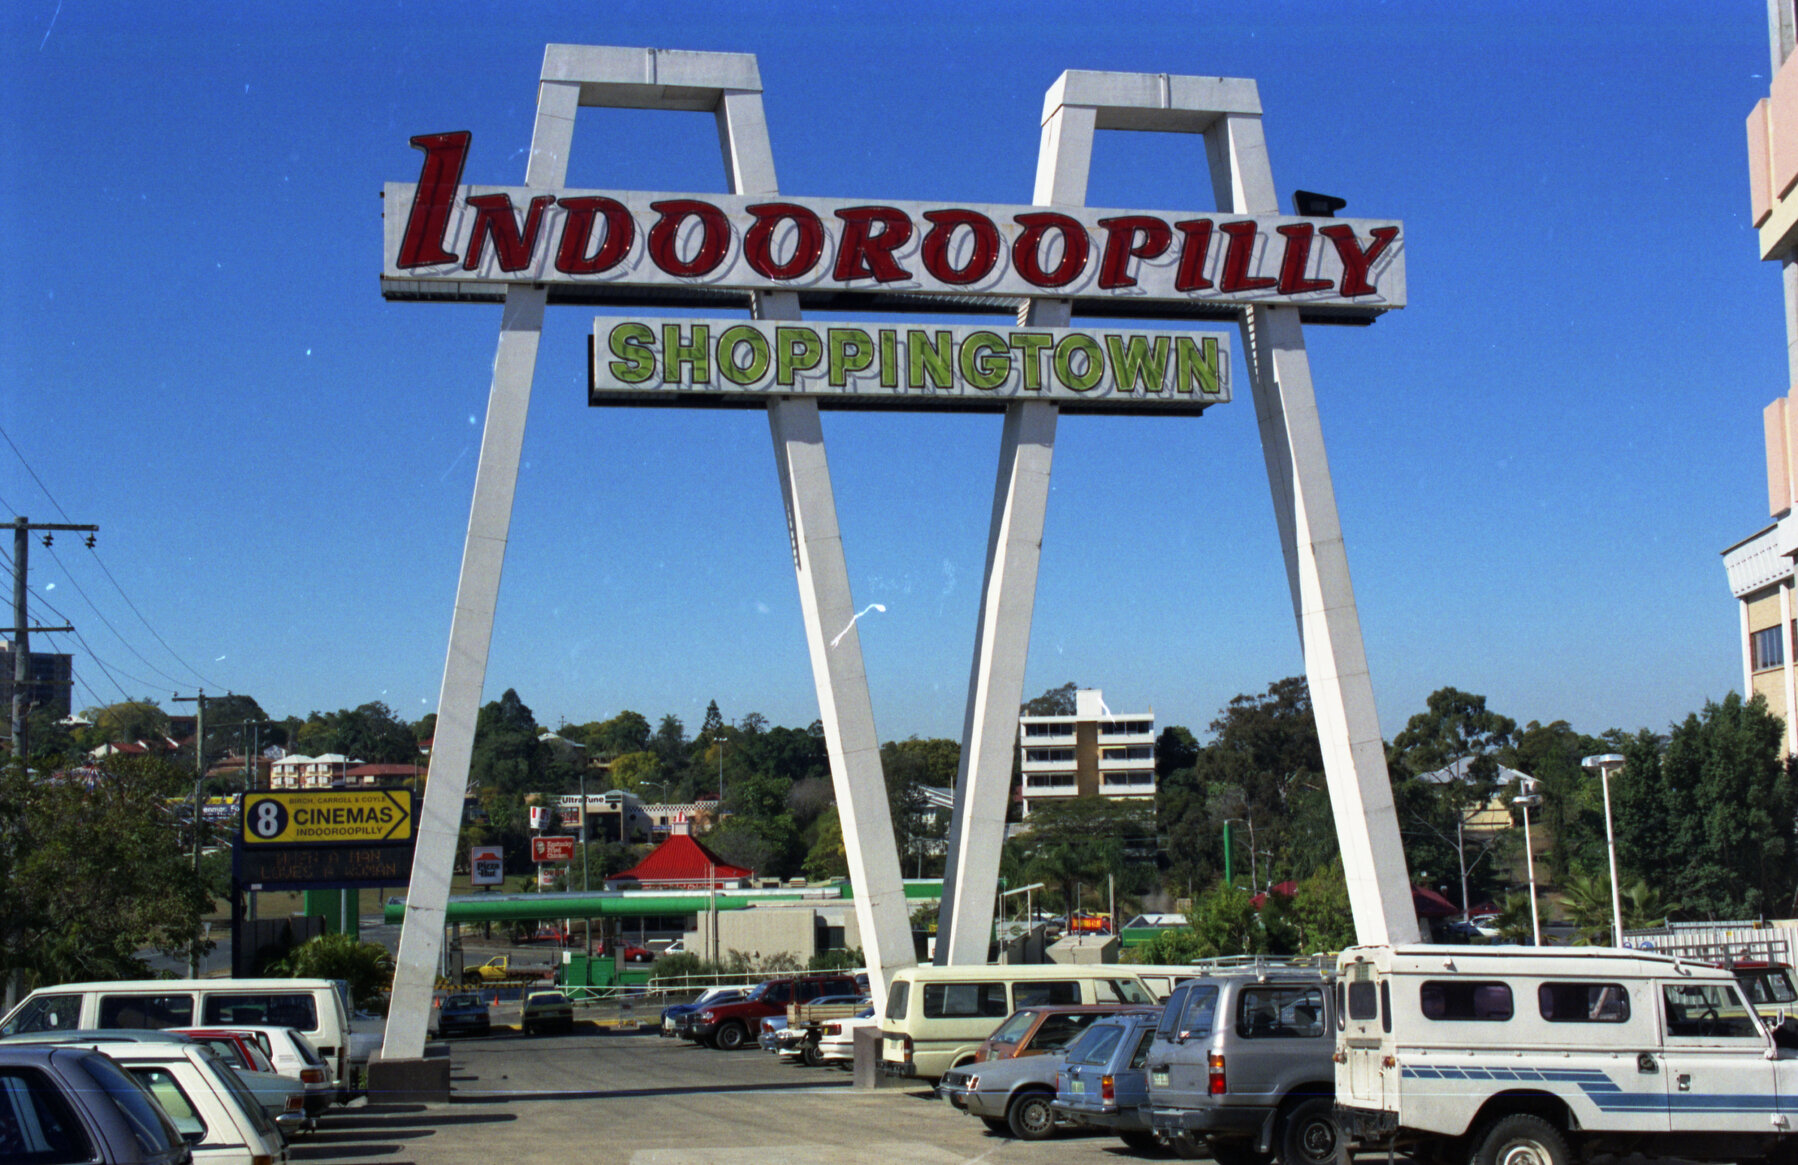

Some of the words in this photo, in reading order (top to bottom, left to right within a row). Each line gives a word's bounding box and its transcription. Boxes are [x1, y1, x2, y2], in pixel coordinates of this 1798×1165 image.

[397, 131, 1399, 297] INDOOROOPILLY
[609, 323, 1220, 394] SHOPPINGTOWN
[257, 802, 278, 836] 8
[294, 807, 393, 825] CINEMAS
[296, 826, 384, 836] INDOOROOPILLY
[477, 861, 500, 870] Pizza
[478, 869, 496, 877] Hut
